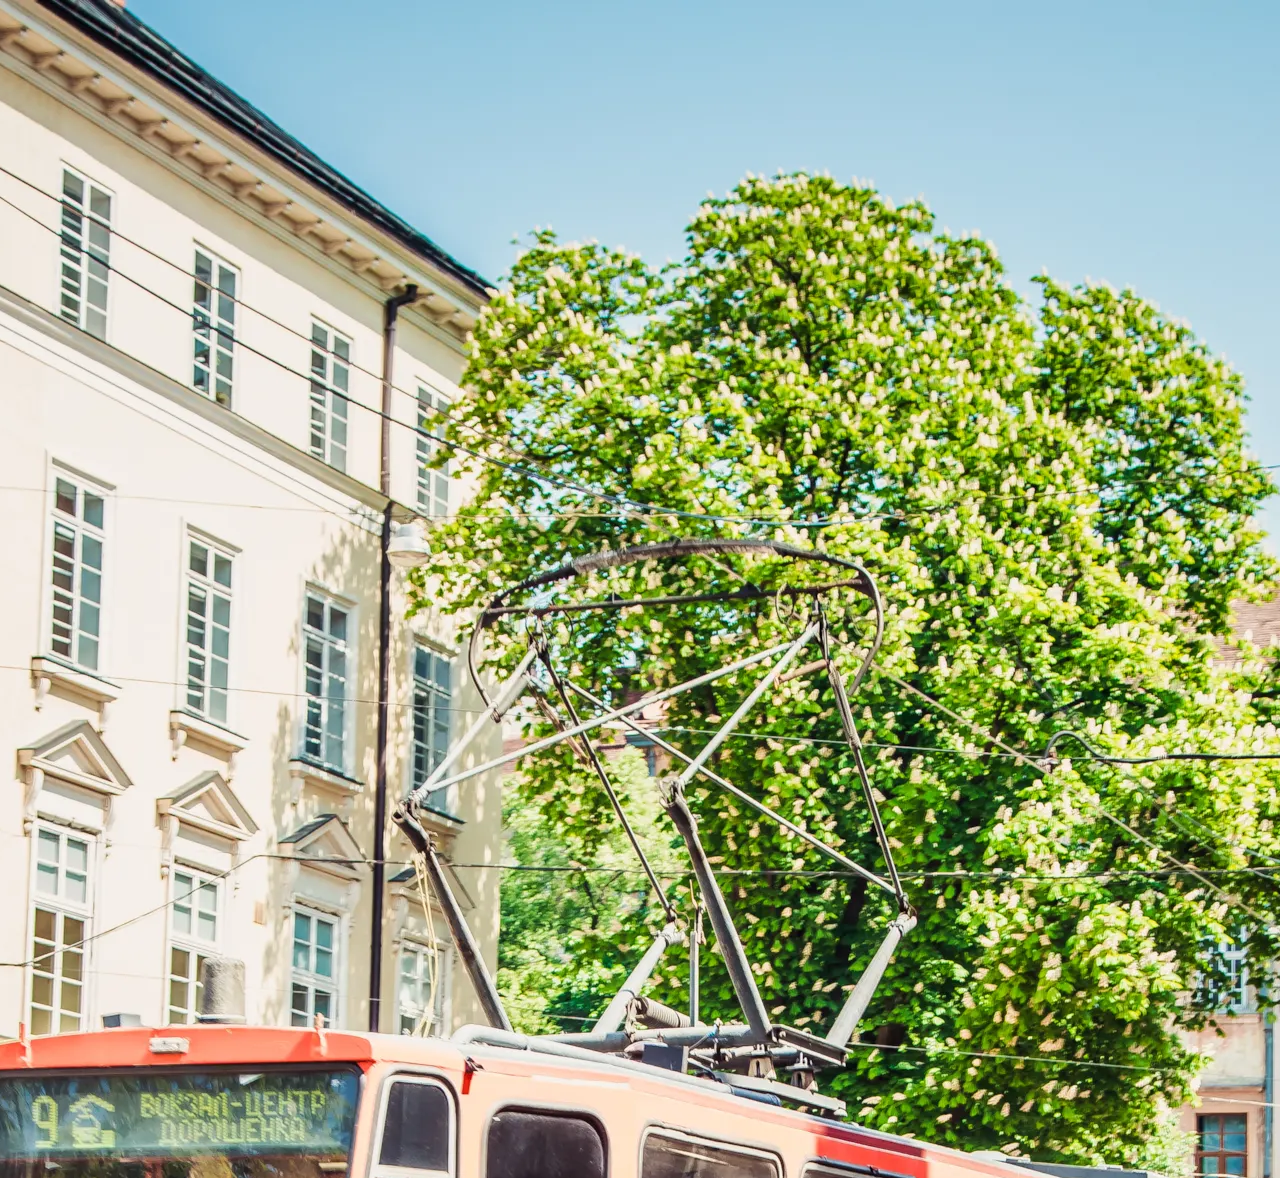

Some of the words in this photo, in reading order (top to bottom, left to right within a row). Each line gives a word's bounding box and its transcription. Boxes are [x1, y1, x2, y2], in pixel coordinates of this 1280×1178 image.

[32, 1095, 59, 1149] 9
[140, 1090, 326, 1120] ВОКЗАЛ-ЦЕНТР
[158, 1117, 306, 1147] ДОРОШЕНКА
